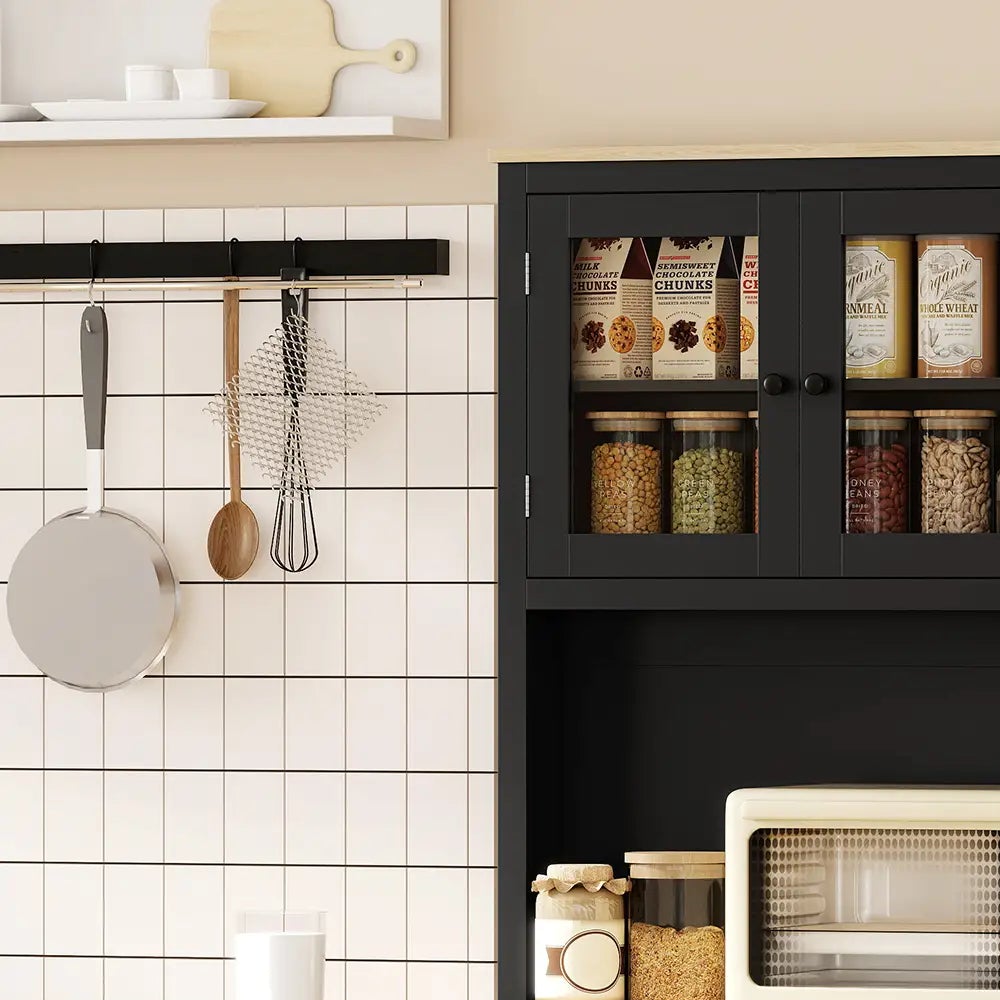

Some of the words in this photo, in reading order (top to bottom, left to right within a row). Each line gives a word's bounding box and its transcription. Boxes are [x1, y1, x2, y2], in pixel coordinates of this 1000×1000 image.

[574, 262, 600, 271] MILK
[657, 262, 716, 270] SEMISWEET
[654, 280, 713, 290] CHUNKS
[920, 303, 943, 313] WHOLE
[945, 303, 979, 313] WHEAT
[594, 479, 634, 488] YELLOW
[600, 490, 627, 499] PEAS
[682, 490, 708, 499] PEAS
